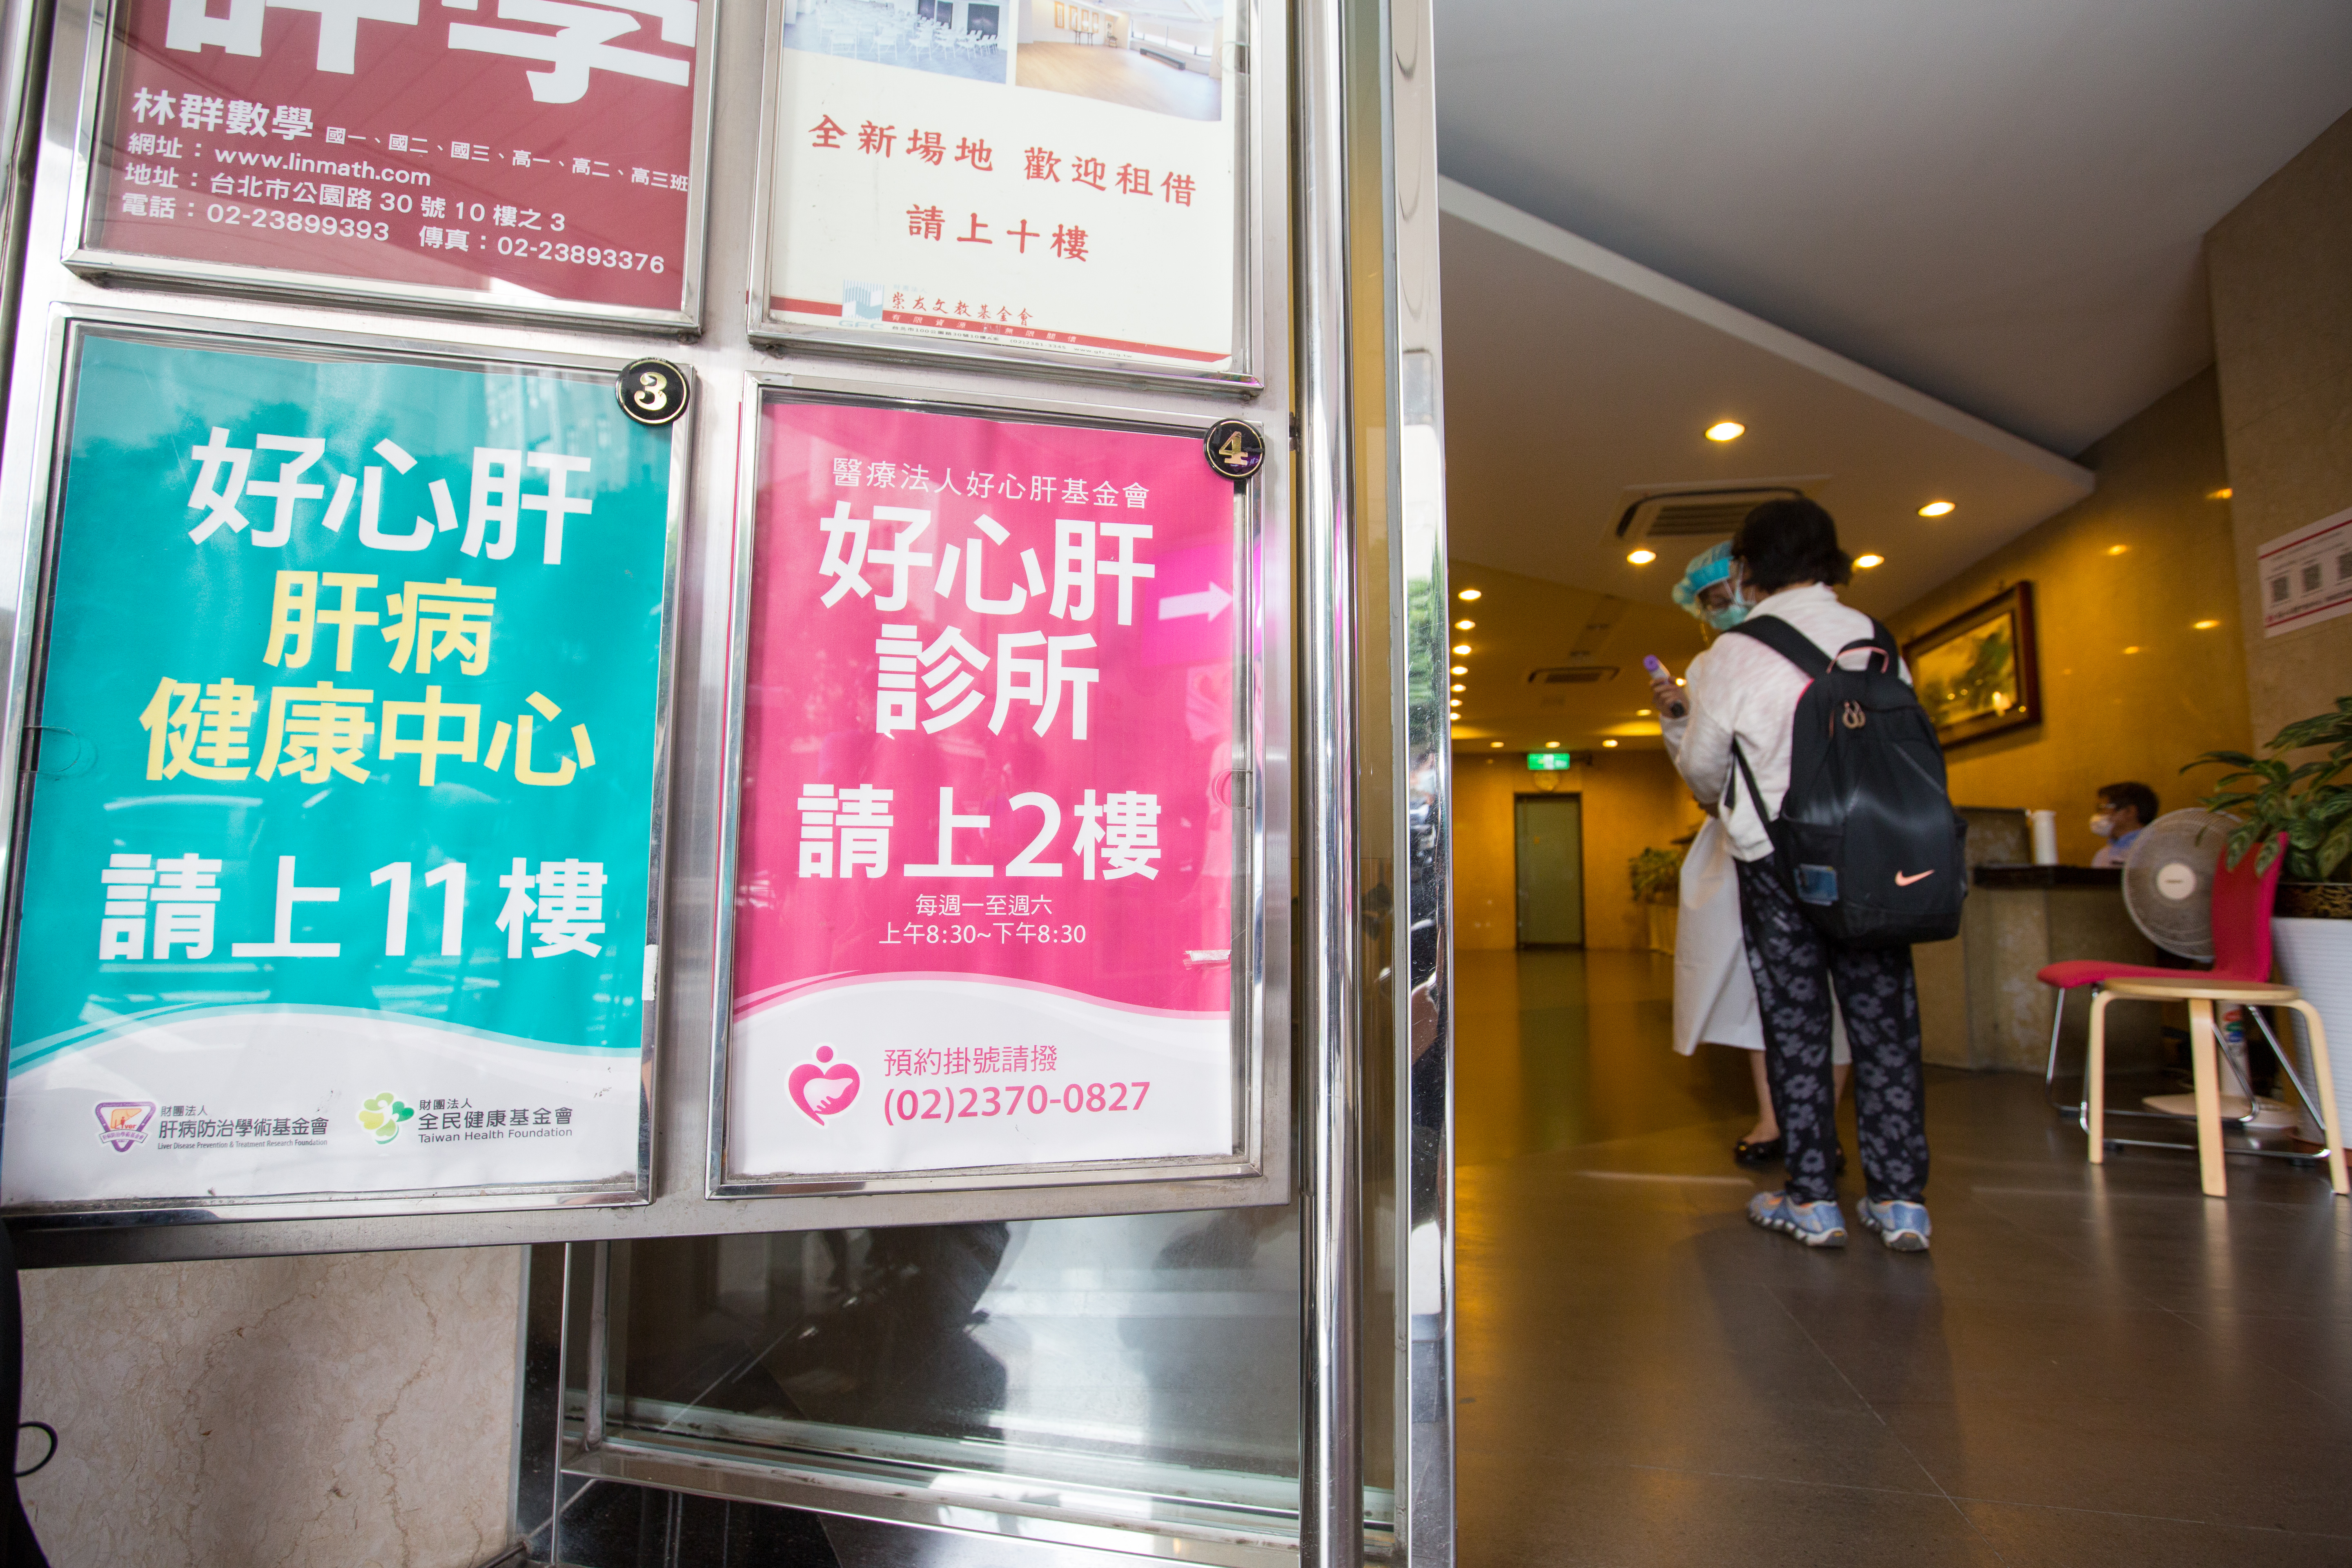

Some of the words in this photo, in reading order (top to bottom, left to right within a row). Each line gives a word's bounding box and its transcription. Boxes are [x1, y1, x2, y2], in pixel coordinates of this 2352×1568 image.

[132, 87, 314, 140] 林群數學
[326, 126, 688, 192] 國一、國二、國三、高一、高二、高三班
[808, 114, 993, 172] 全新場地
[1023, 147, 1196, 207] 歡迎租借
[906, 204, 1089, 262] 請上十樓
[838, 320, 884, 330] GFC
[634, 372, 667, 410] 3
[1219, 431, 1248, 465] 4
[188, 427, 592, 565] 好心肝
[833, 457, 1149, 509] 醫療法人好心肝基金會
[819, 501, 1155, 627] 好心肝
[263, 570, 497, 676] 肝病
[874, 623, 1100, 741] 診所
[139, 676, 597, 787] 健康中心
[797, 783, 1161, 881] 請上2樓
[915, 894, 1052, 916] 每週一至週六
[879, 922, 1086, 944] 上午8:30~下午8:30
[884, 1045, 1057, 1076] 預約掛號請撥
[161, 1105, 208, 1116] 財團法人
[418, 1107, 573, 1130] 全民健康基金會
[419, 1098, 472, 1110] 財團法人
[884, 1081, 1150, 1126] (02)2370-0827
[158, 1117, 329, 1138] 肝病防治學術基金會
[418, 1133, 460, 1143] Taiwan
[465, 1130, 503, 1140] Health
[508, 1128, 573, 1138] Foundation
